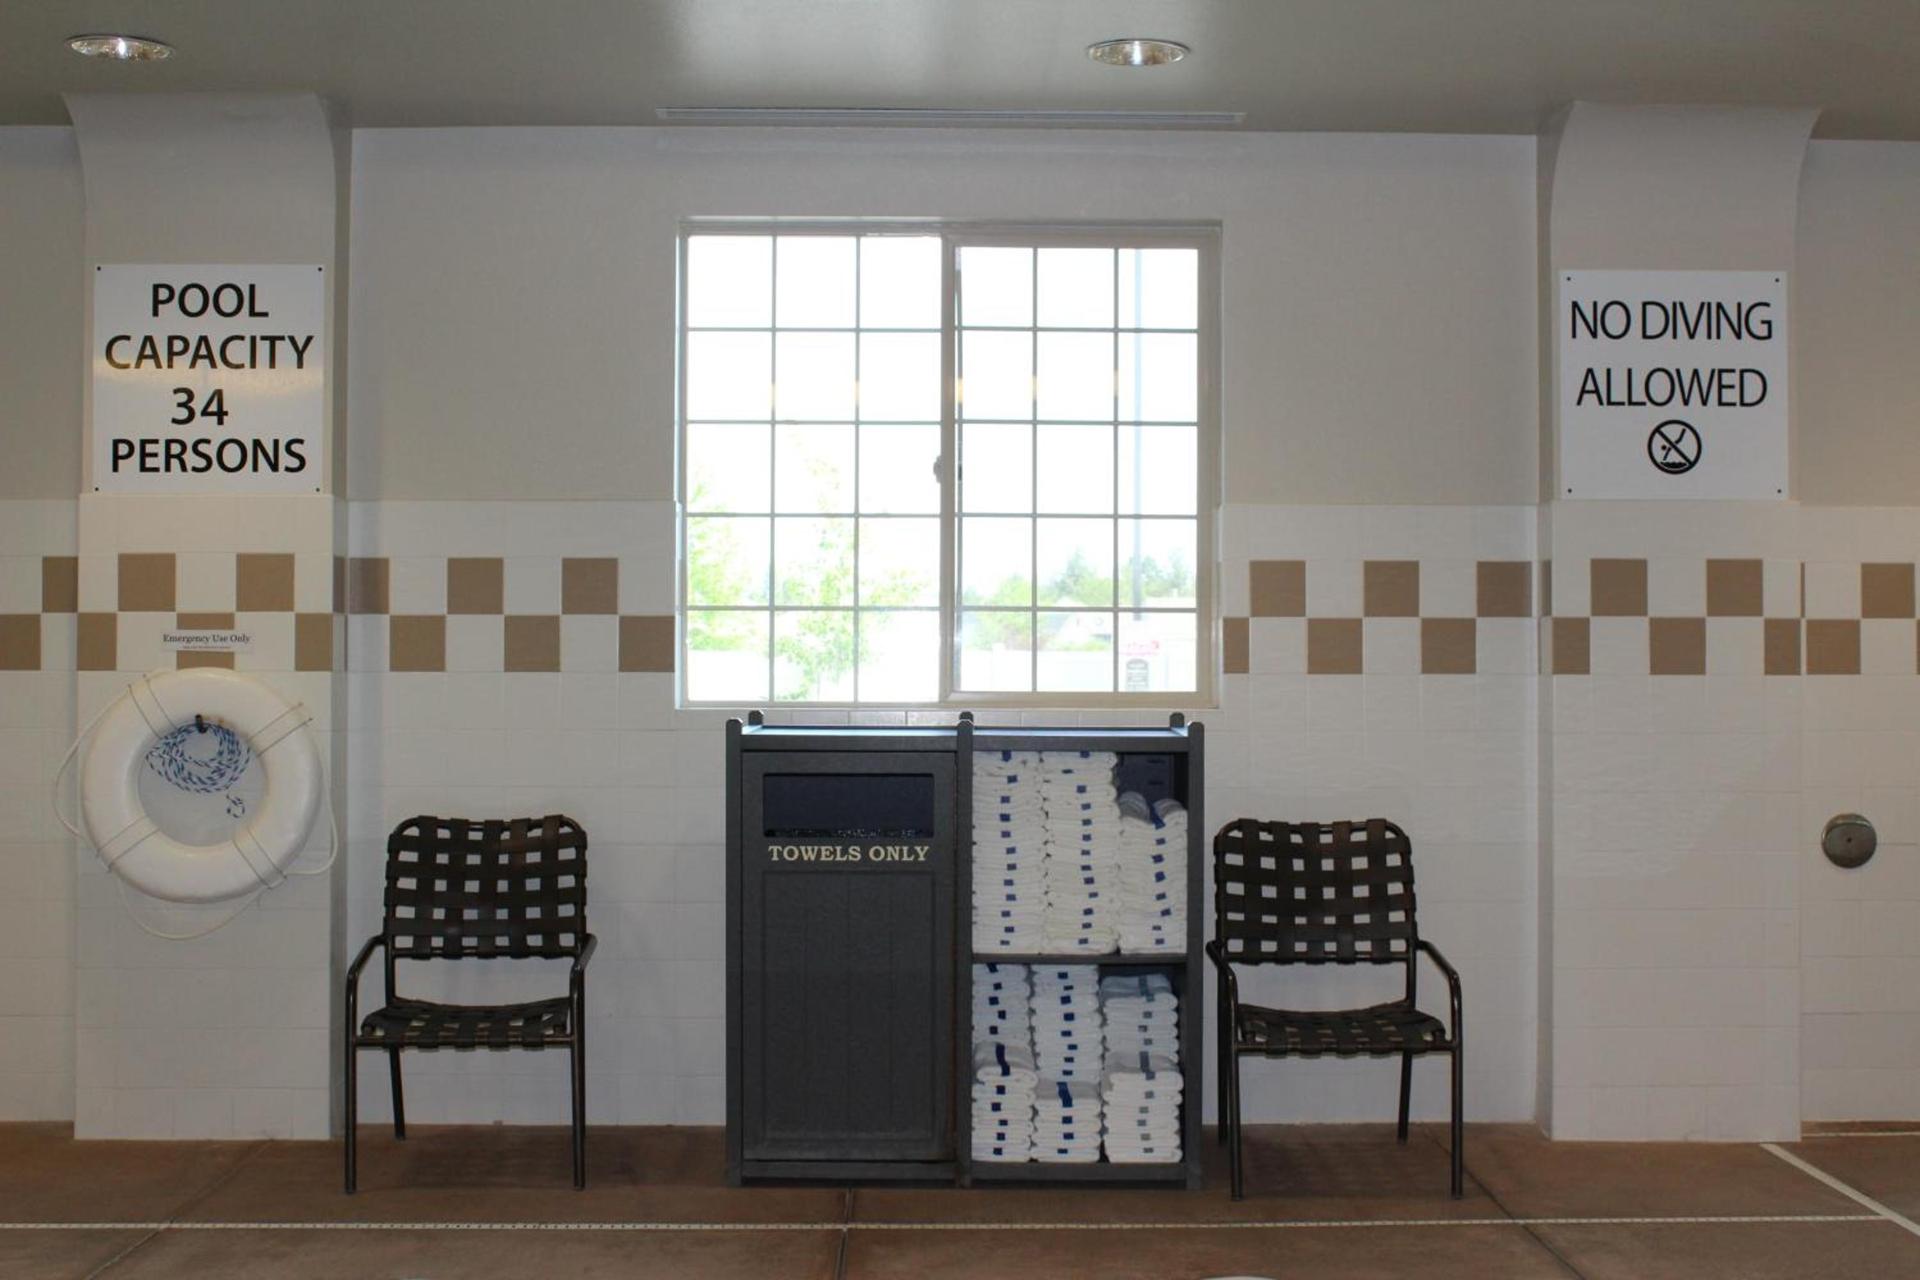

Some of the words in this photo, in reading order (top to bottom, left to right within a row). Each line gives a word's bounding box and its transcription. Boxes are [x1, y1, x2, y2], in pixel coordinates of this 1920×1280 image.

[152, 283, 269, 318] POOL
[1571, 300, 1631, 340] NO
[1641, 301, 1773, 341] DIVING
[105, 335, 314, 370] CAPACITY
[1576, 367, 1768, 407] ALLOWED
[171, 387, 229, 426] 34
[111, 438, 307, 473] PERSONS
[163, 634, 210, 644] Emergency
[212, 634, 228, 643] Use
[230, 634, 250, 644] Only
[768, 845, 861, 862] TOWELS
[868, 845, 930, 862] ONLY
